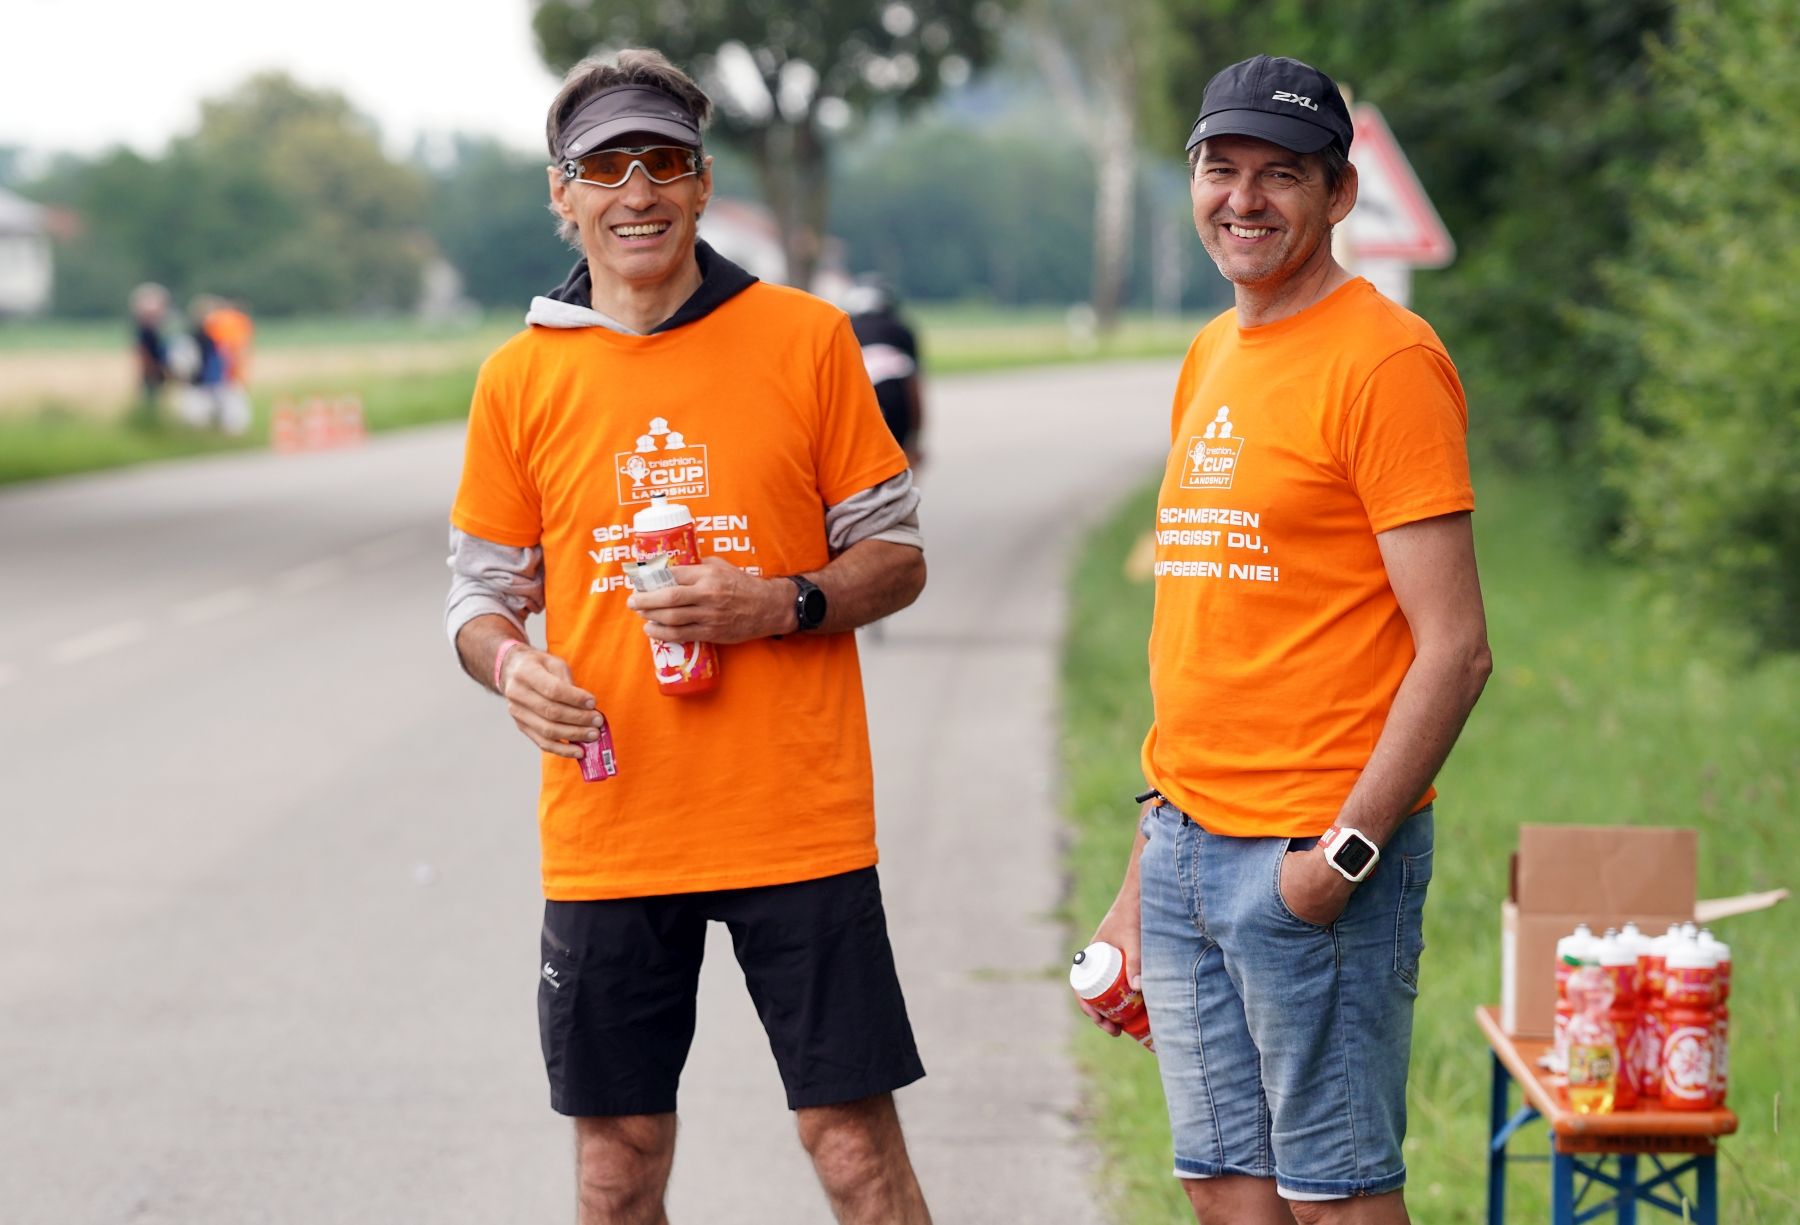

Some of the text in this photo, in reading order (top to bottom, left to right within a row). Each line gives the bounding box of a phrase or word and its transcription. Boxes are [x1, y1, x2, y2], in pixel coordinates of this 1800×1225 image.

[1203, 457, 1234, 472] CUP
[650, 466, 704, 485] CUP
[1189, 476, 1230, 485] LANDSHUT
[1160, 508, 1260, 528] SCHMERZEN
[592, 514, 748, 543] SCHZEN
[713, 536, 756, 555] DU,
[1156, 530, 1269, 554] VERGISST DU,
[1228, 563, 1279, 582] NIE!
